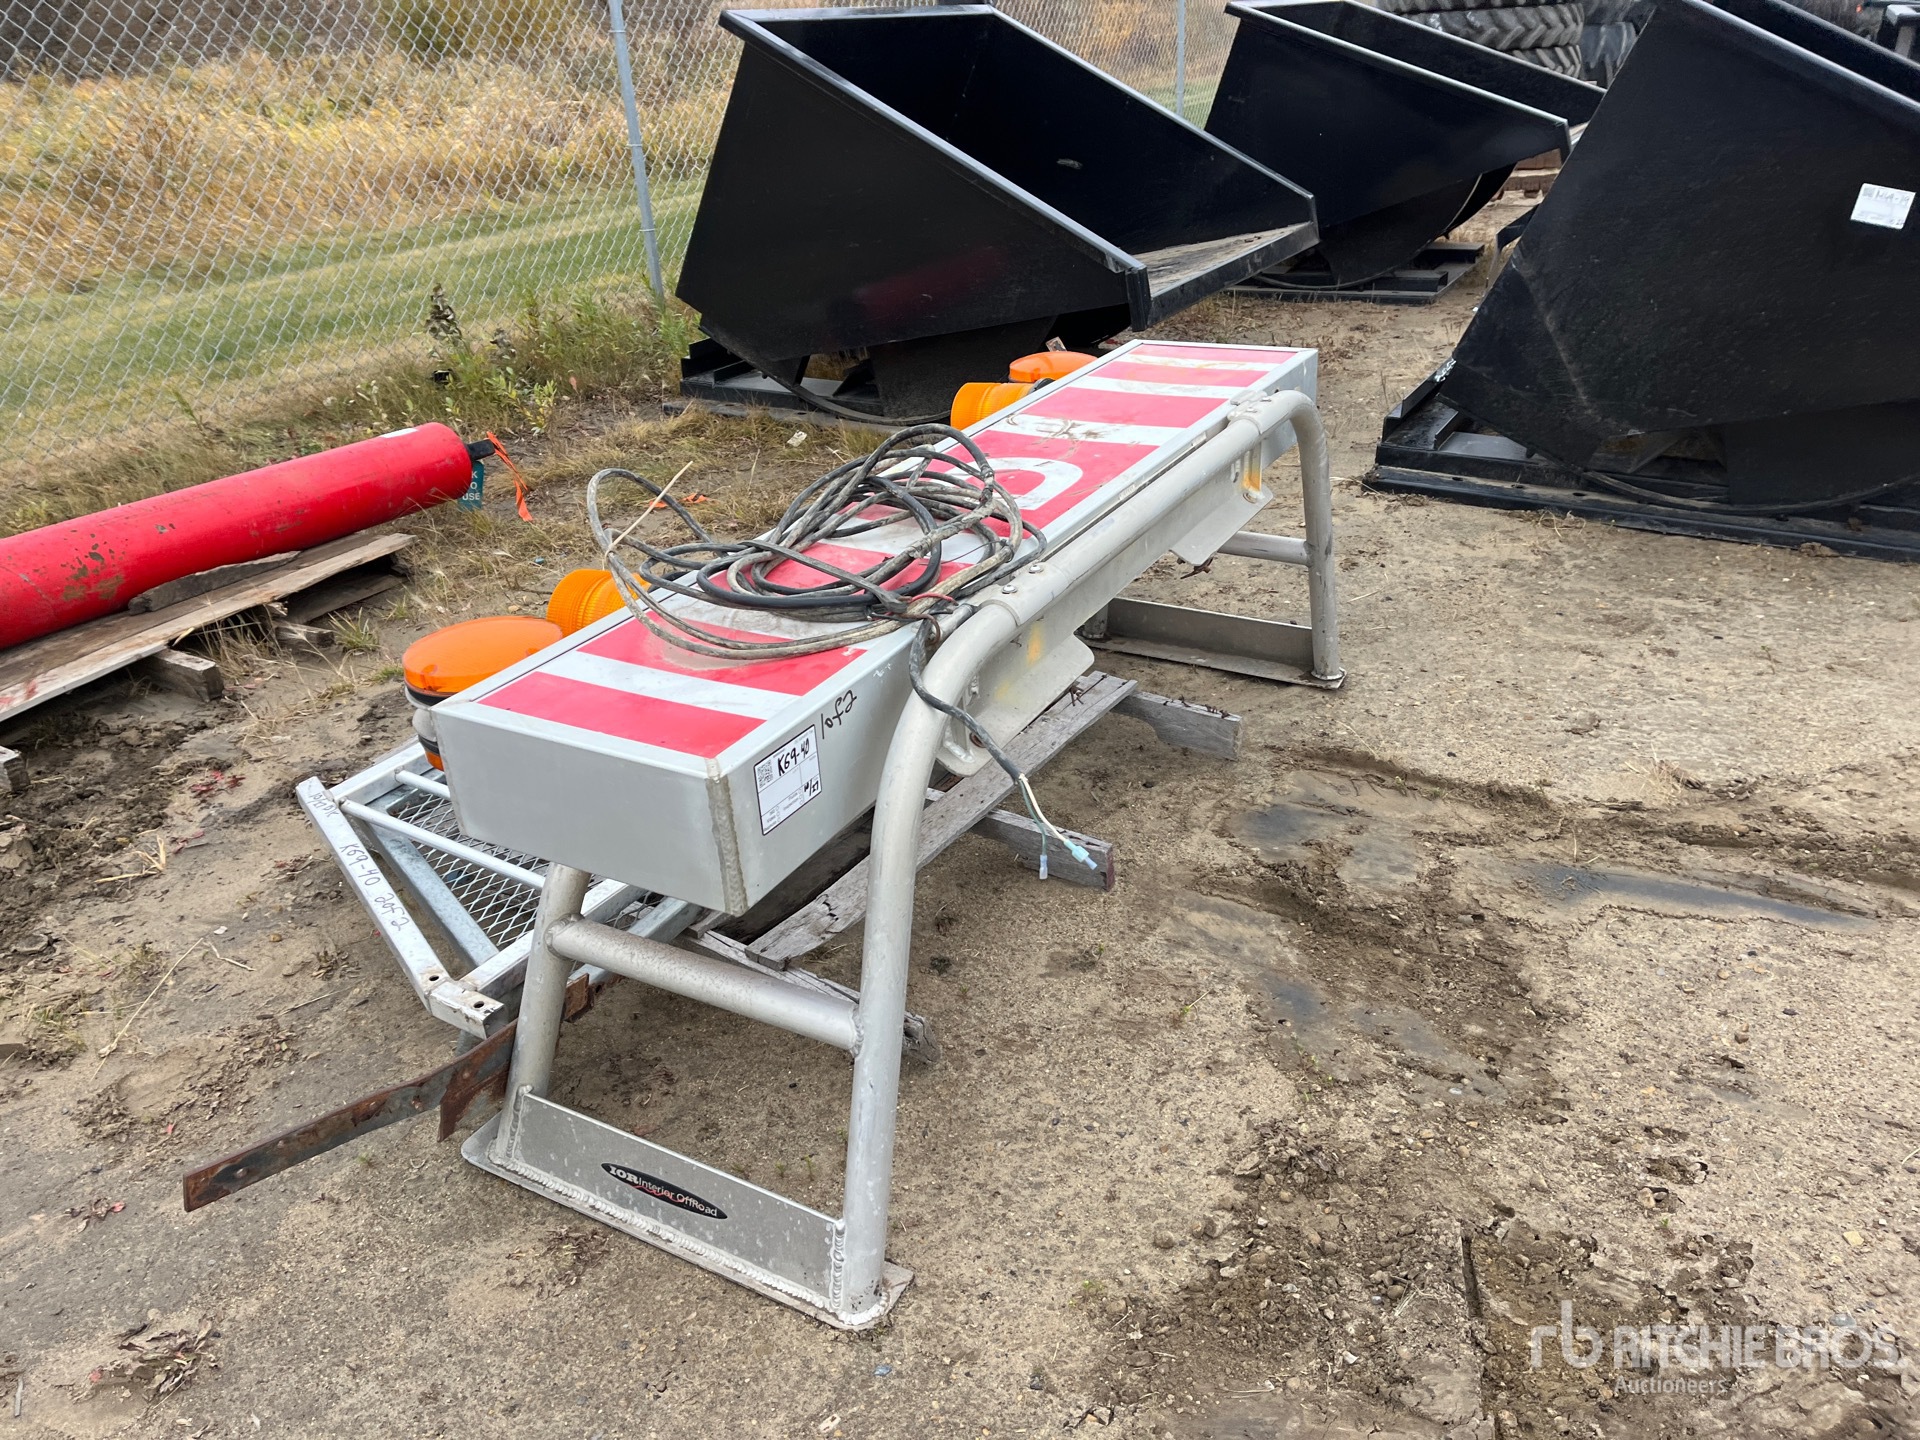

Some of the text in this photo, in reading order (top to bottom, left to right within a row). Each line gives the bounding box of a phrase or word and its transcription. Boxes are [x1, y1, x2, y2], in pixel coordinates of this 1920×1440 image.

[777, 738, 810, 776] K69-40
[339, 843, 381, 886] K69-40
[609, 1165, 639, 1185] IOR
